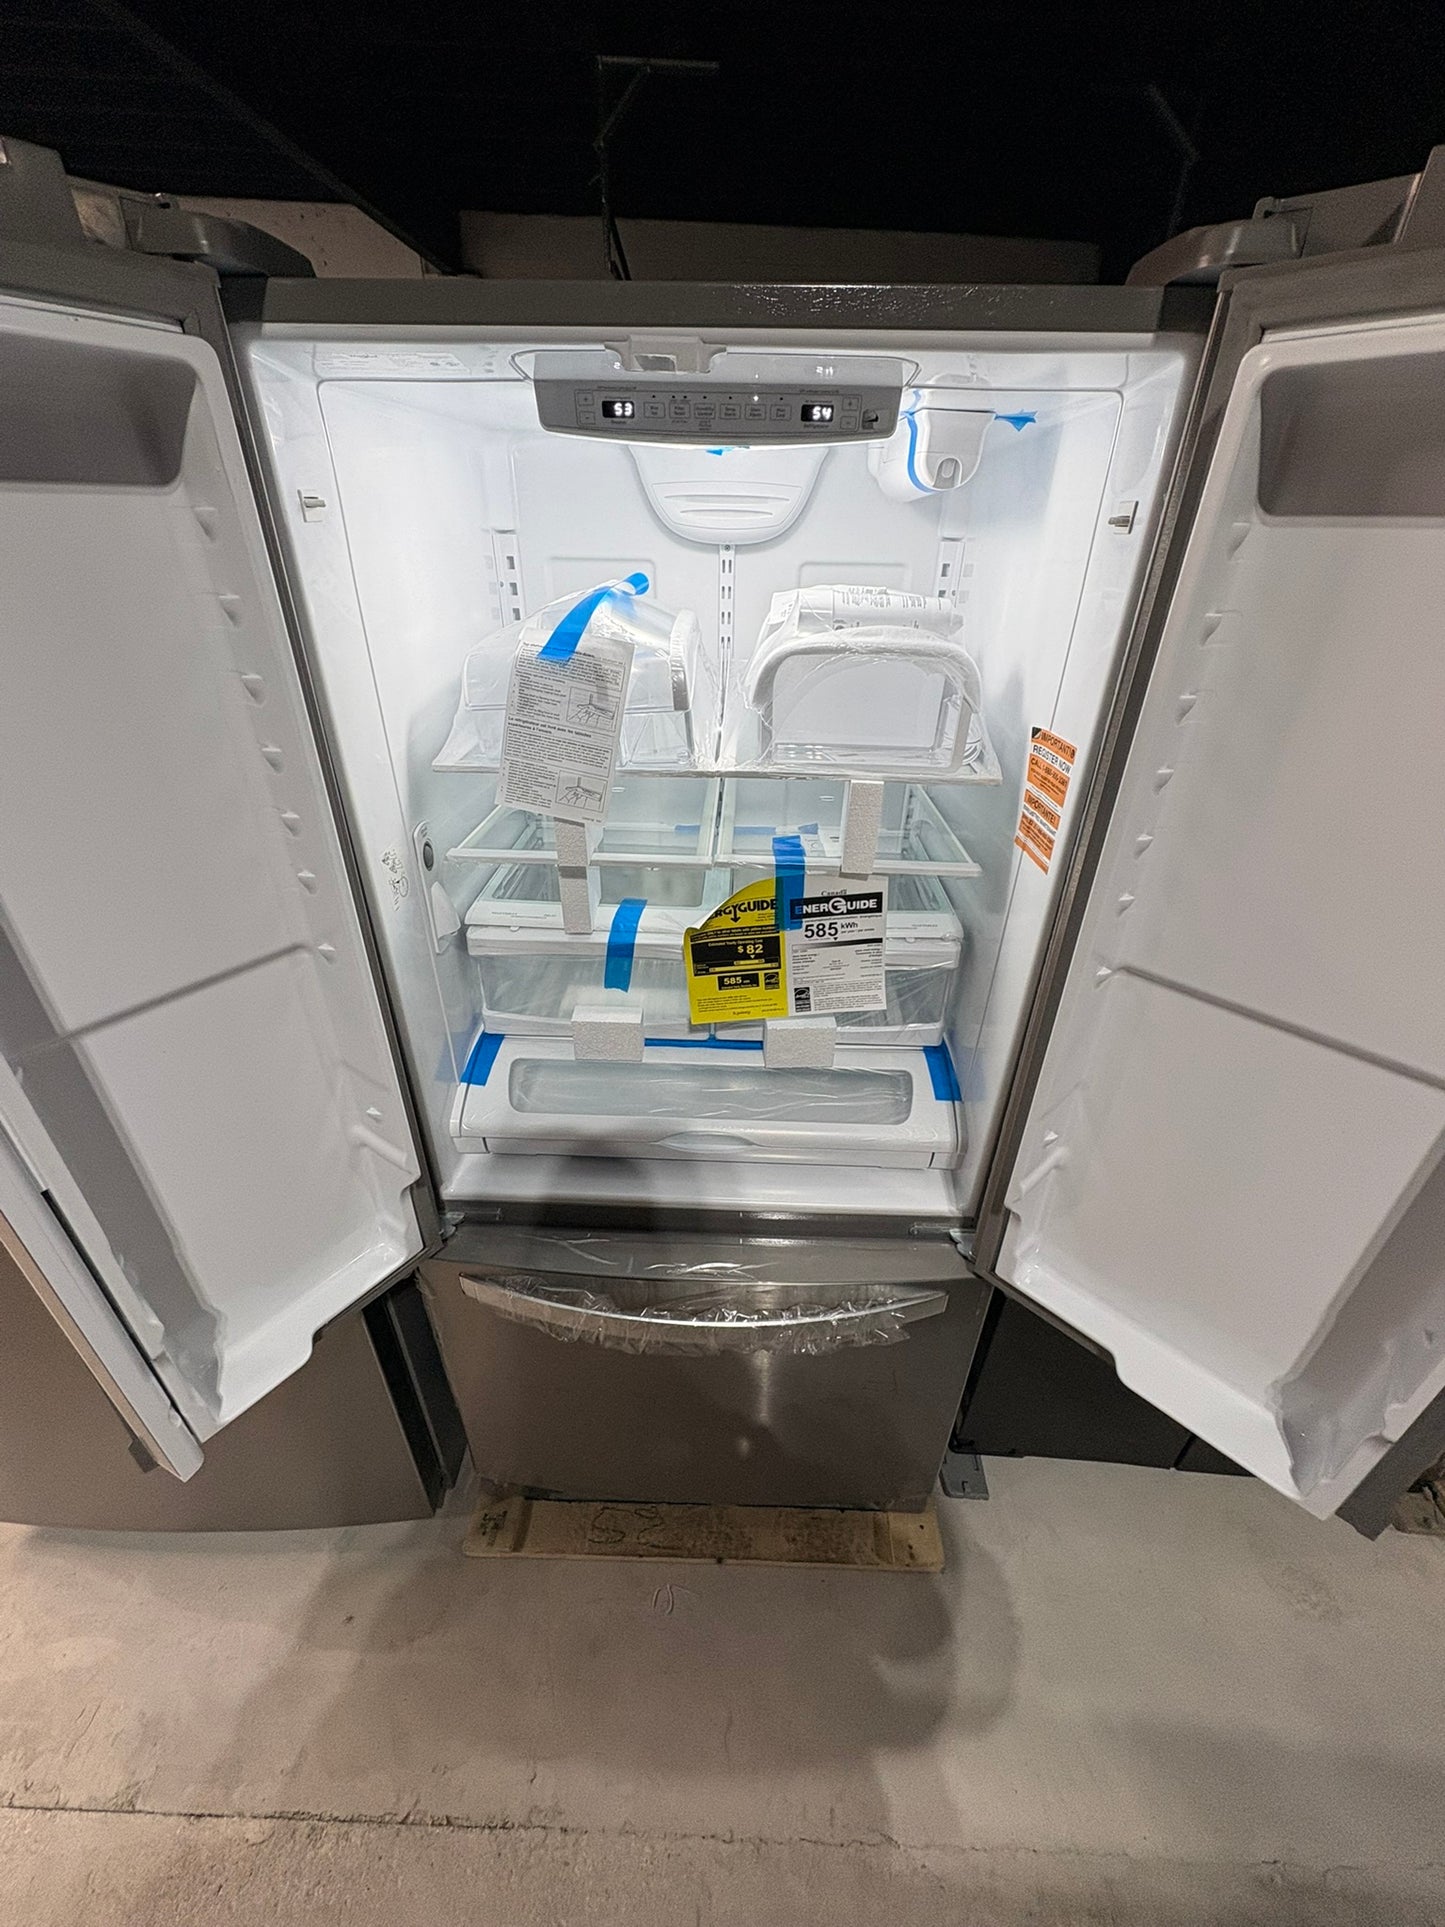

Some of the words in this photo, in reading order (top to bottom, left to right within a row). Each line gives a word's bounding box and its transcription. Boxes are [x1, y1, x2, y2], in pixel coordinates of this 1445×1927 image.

[804, 921, 839, 939] 585
[737, 945, 744, 954] $
[746, 944, 764, 954] 82
[723, 977, 742, 985] 585
